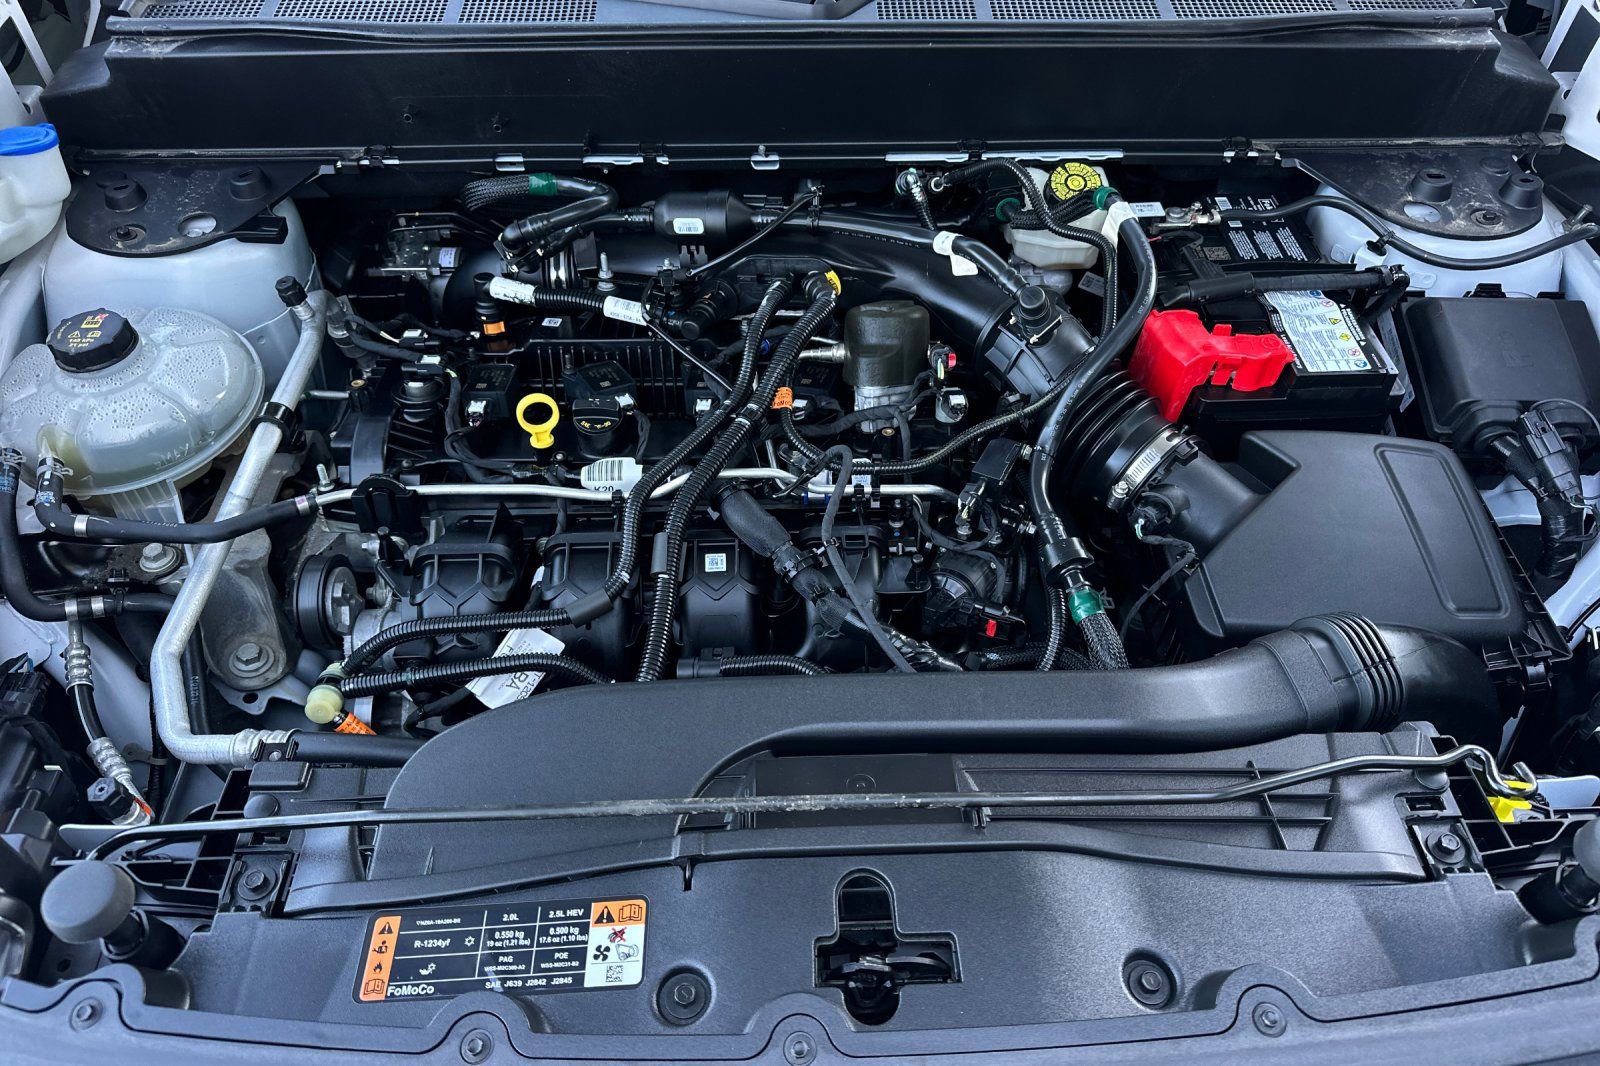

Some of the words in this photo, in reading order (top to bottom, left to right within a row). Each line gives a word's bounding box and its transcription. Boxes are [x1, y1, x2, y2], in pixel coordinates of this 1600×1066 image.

[567, 909, 584, 917] HEV
[549, 927, 568, 935] 0.500
[570, 926, 579, 935] kg
[495, 931, 513, 939] 0.550
[515, 931, 524, 939] kg
[576, 934, 588, 942] lbs)
[414, 939, 450, 949] R-1234yf
[387, 984, 434, 996] FoMoCo
